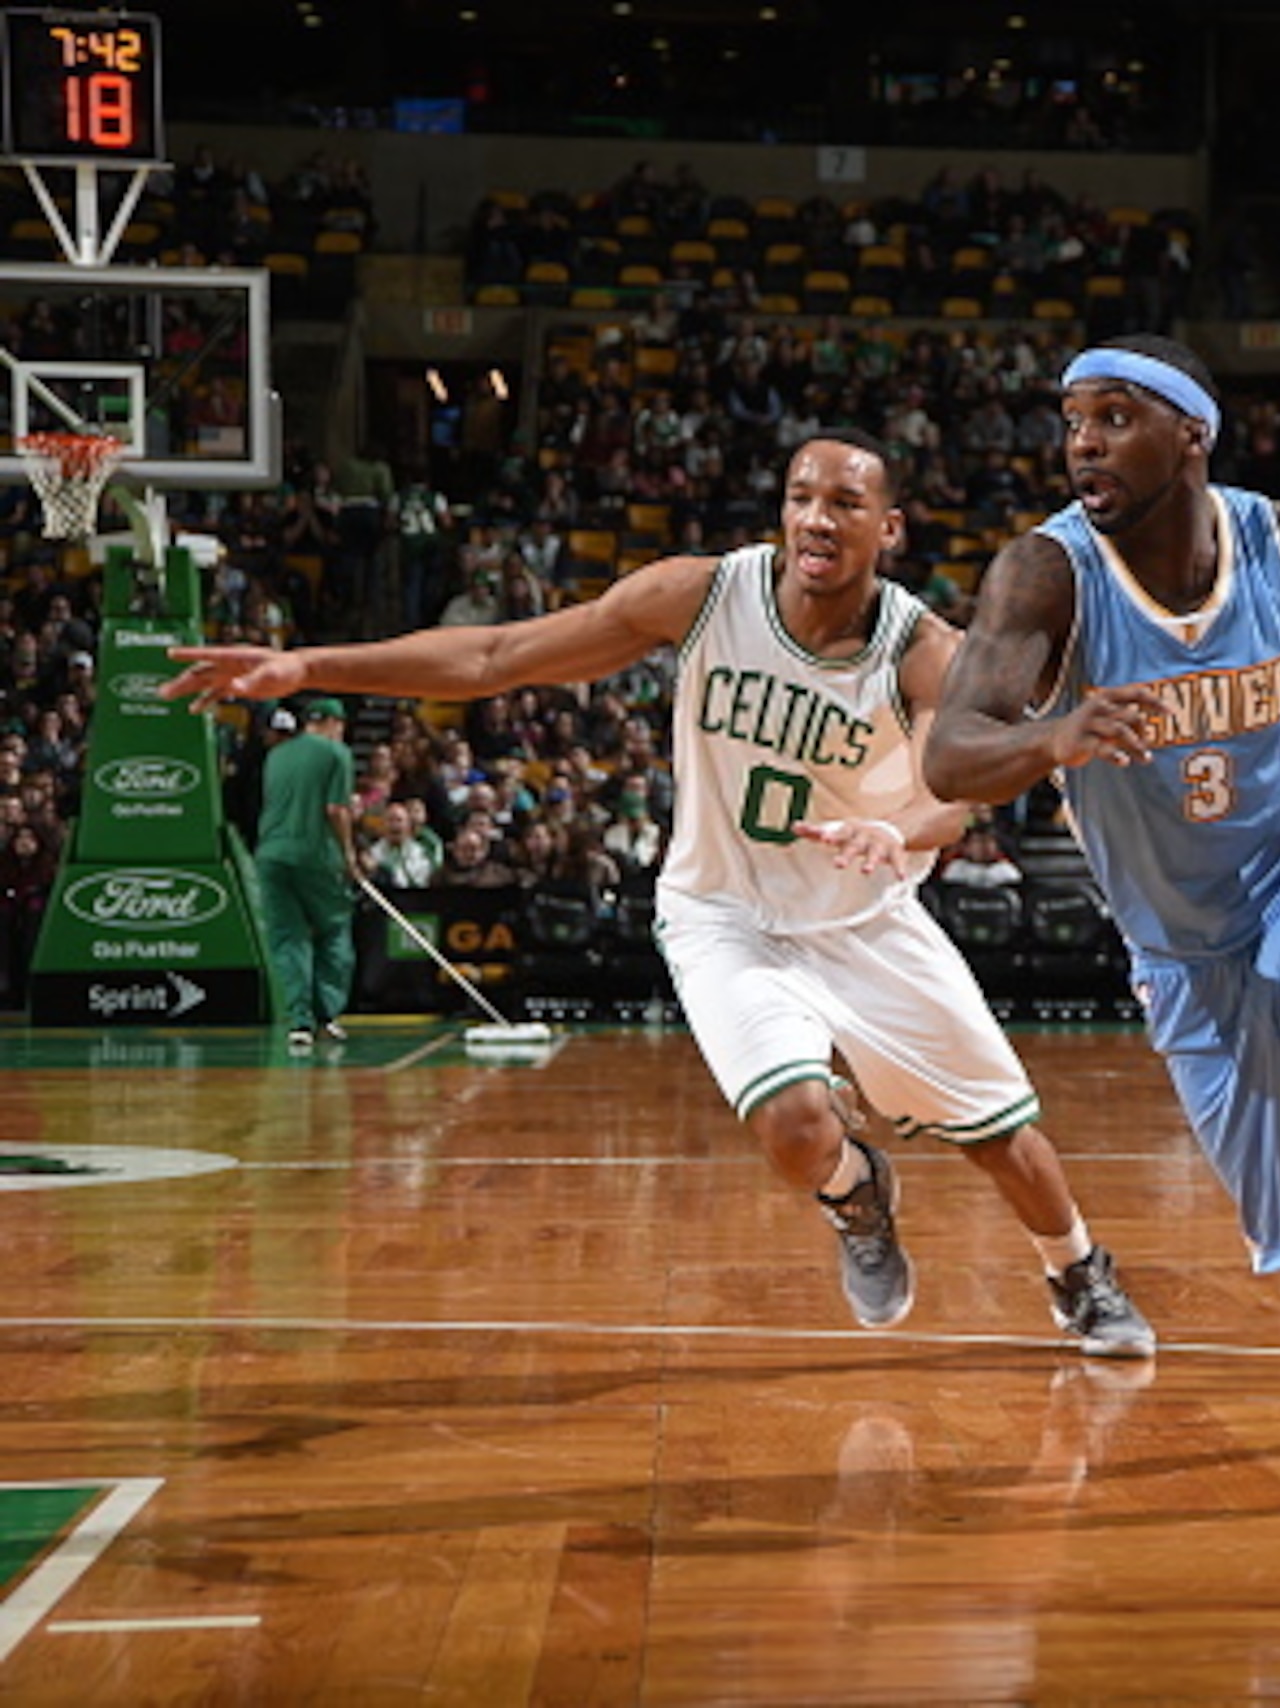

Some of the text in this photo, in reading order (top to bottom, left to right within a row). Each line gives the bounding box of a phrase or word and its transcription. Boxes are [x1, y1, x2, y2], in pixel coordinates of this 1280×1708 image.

[49, 27, 142, 72] 7:42
[66, 73, 132, 147] 18
[699, 666, 874, 768] CELTICS
[741, 763, 812, 845] 0
[1181, 748, 1237, 822] 3
[93, 876, 200, 918] Ford
[92, 941, 200, 958] Go Further
[88, 983, 167, 1016] Sprint
